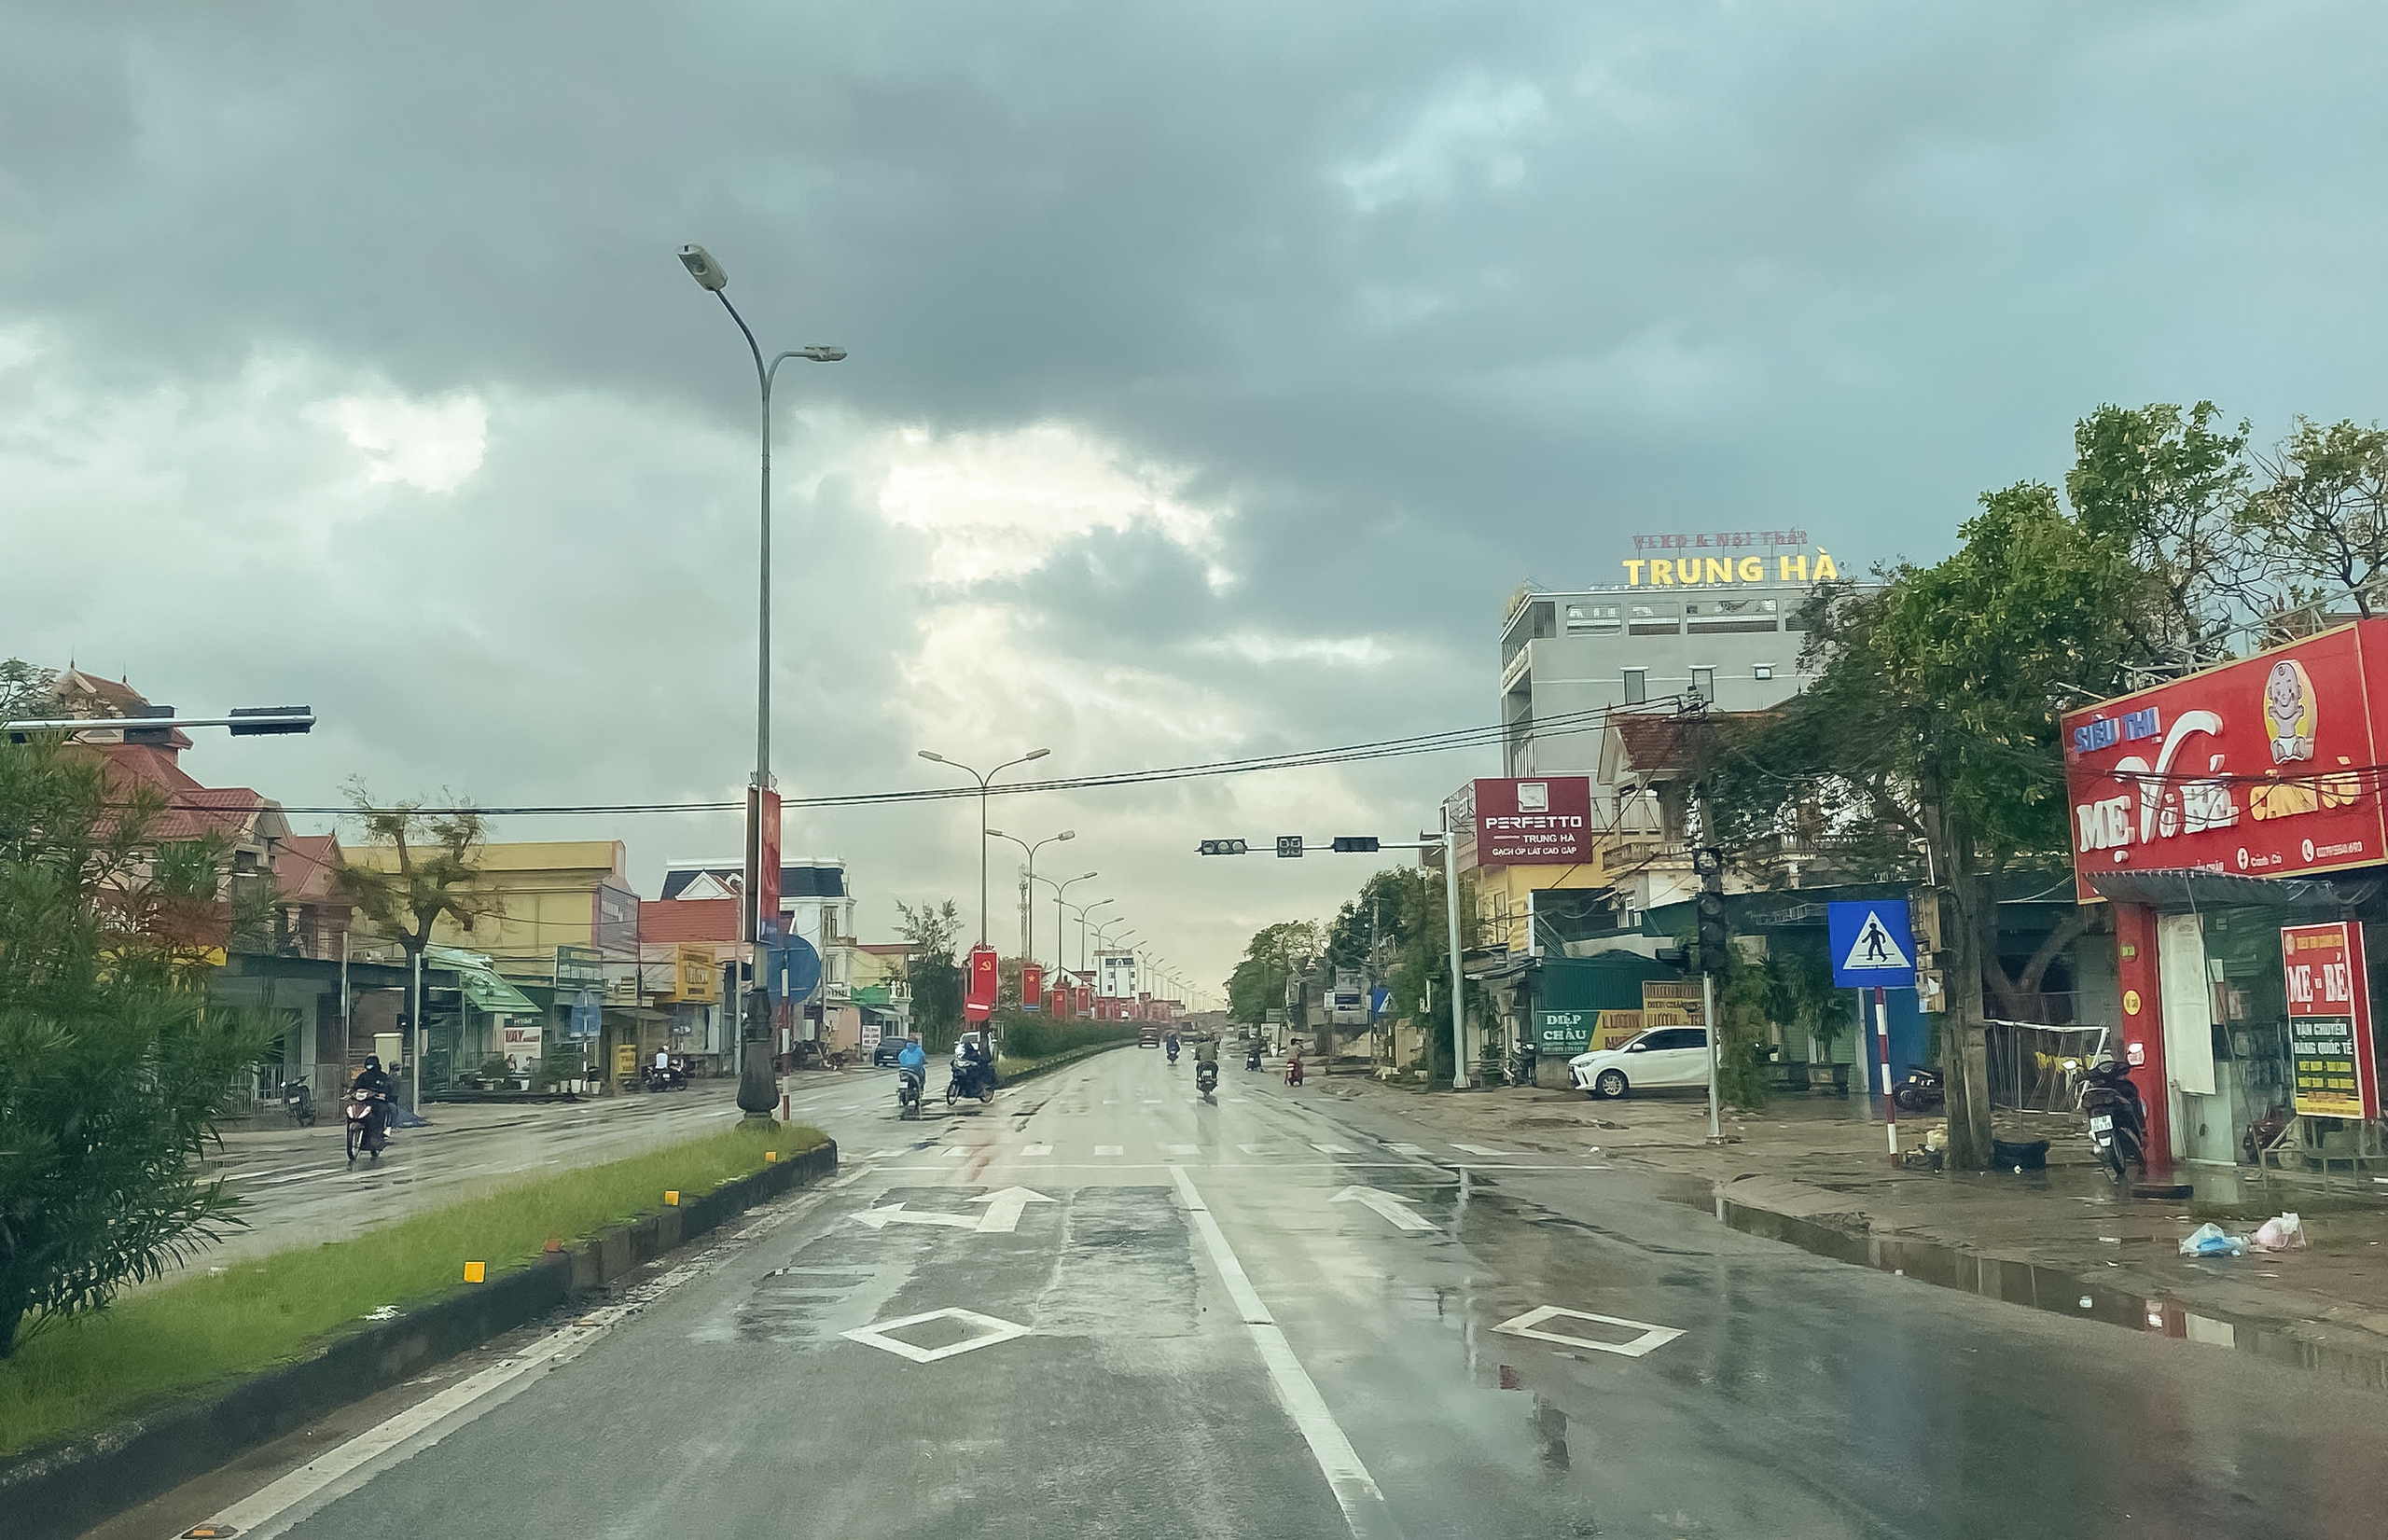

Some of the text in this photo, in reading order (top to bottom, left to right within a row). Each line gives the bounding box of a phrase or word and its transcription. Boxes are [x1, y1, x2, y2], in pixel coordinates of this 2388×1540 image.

[1622, 546, 1839, 586] TRUNG HÀ
[2075, 706, 2162, 753] SIÊU THỊ
[1485, 815, 1583, 829] PERFETTO
[2076, 795, 2136, 864] MẸ
[1522, 832, 1576, 843] TRUNG HÀ
[1492, 848, 1514, 856] GẠCH
[2287, 951, 2348, 1013] MẸ BÉ
[1547, 1013, 1581, 1027] DIỆP
[1543, 1027, 1587, 1040] CHÂU
